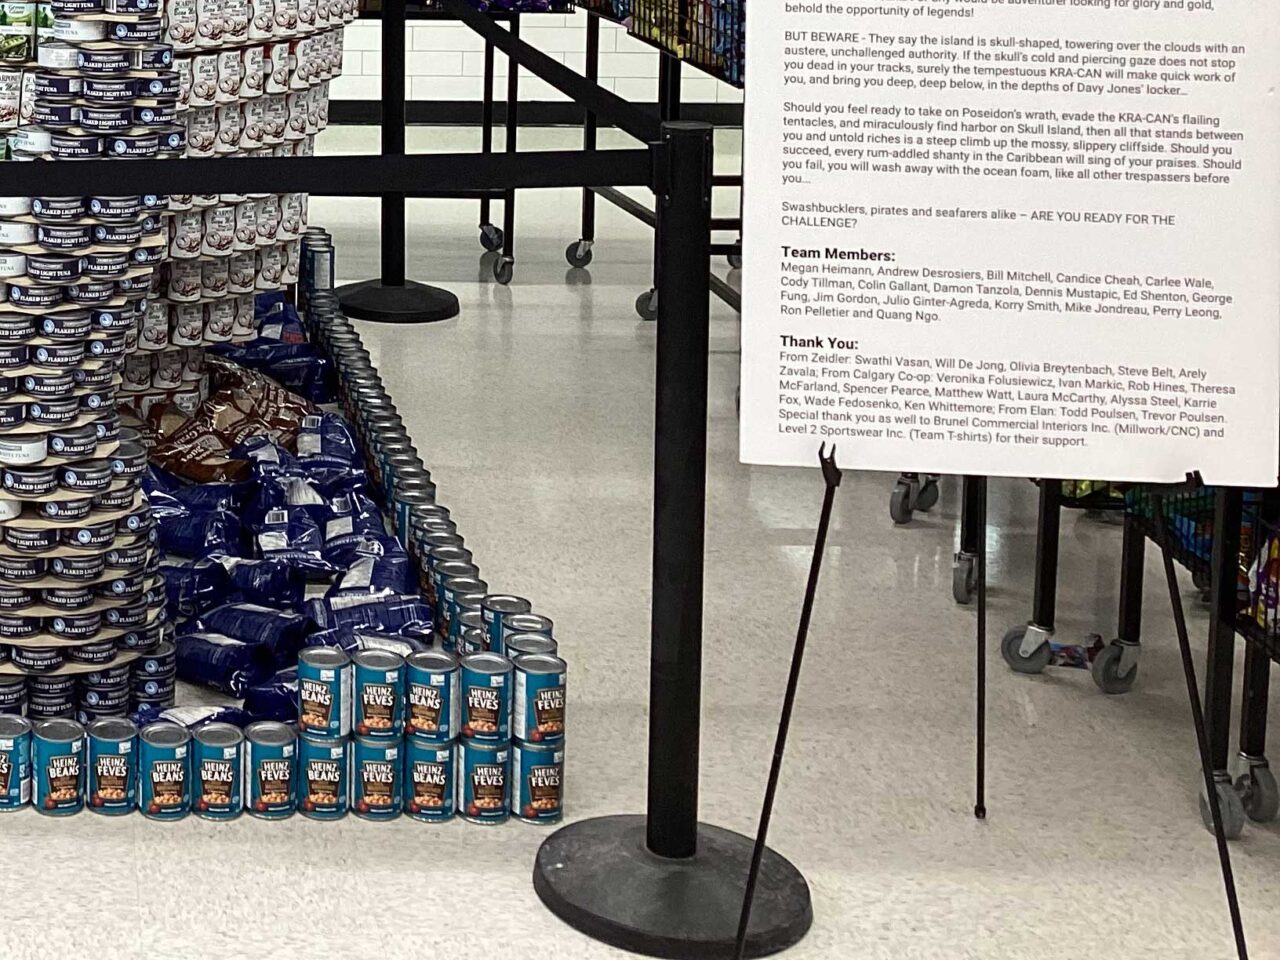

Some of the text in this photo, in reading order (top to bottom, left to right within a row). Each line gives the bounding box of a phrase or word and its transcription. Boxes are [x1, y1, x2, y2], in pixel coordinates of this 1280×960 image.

[785, 2, 974, 19] behold the opportunity of legends!
[1163, 0, 1184, 9] and
[1186, 0, 1214, 11] gold,
[781, 201, 868, 216] Swashbucklers,
[870, 204, 909, 217] pirates
[911, 206, 932, 216] and
[935, 207, 988, 218] seafarers
[990, 208, 1017, 219] alike
[1030, 210, 1054, 220] ARE
[1056, 211, 1081, 221] YOU
[1083, 212, 1123, 222] READY
[1125, 213, 1149, 223] FOR
[1151, 214, 1175, 224] THE
[781, 215, 858, 226] CHALLENGE?
[780, 246, 896, 259] Team Members:
[780, 262, 1214, 290] Megan Heimann, Andrew Desrosiers, Bill Mitchell, Candice Cheah, Carlee Wale,
[779, 335, 859, 347] Thank You:
[778, 423, 1087, 448] Level 2 Sportswear Inc. (Team T-shirts) for their support.
[366, 686, 392, 697] HEINZ
[363, 694, 394, 706] FEVES
[53, 757, 78, 768] HEINZ
[49, 766, 80, 778] BEANS
[476, 767, 502, 778] HEINZ
[474, 775, 504, 786] FEVES
